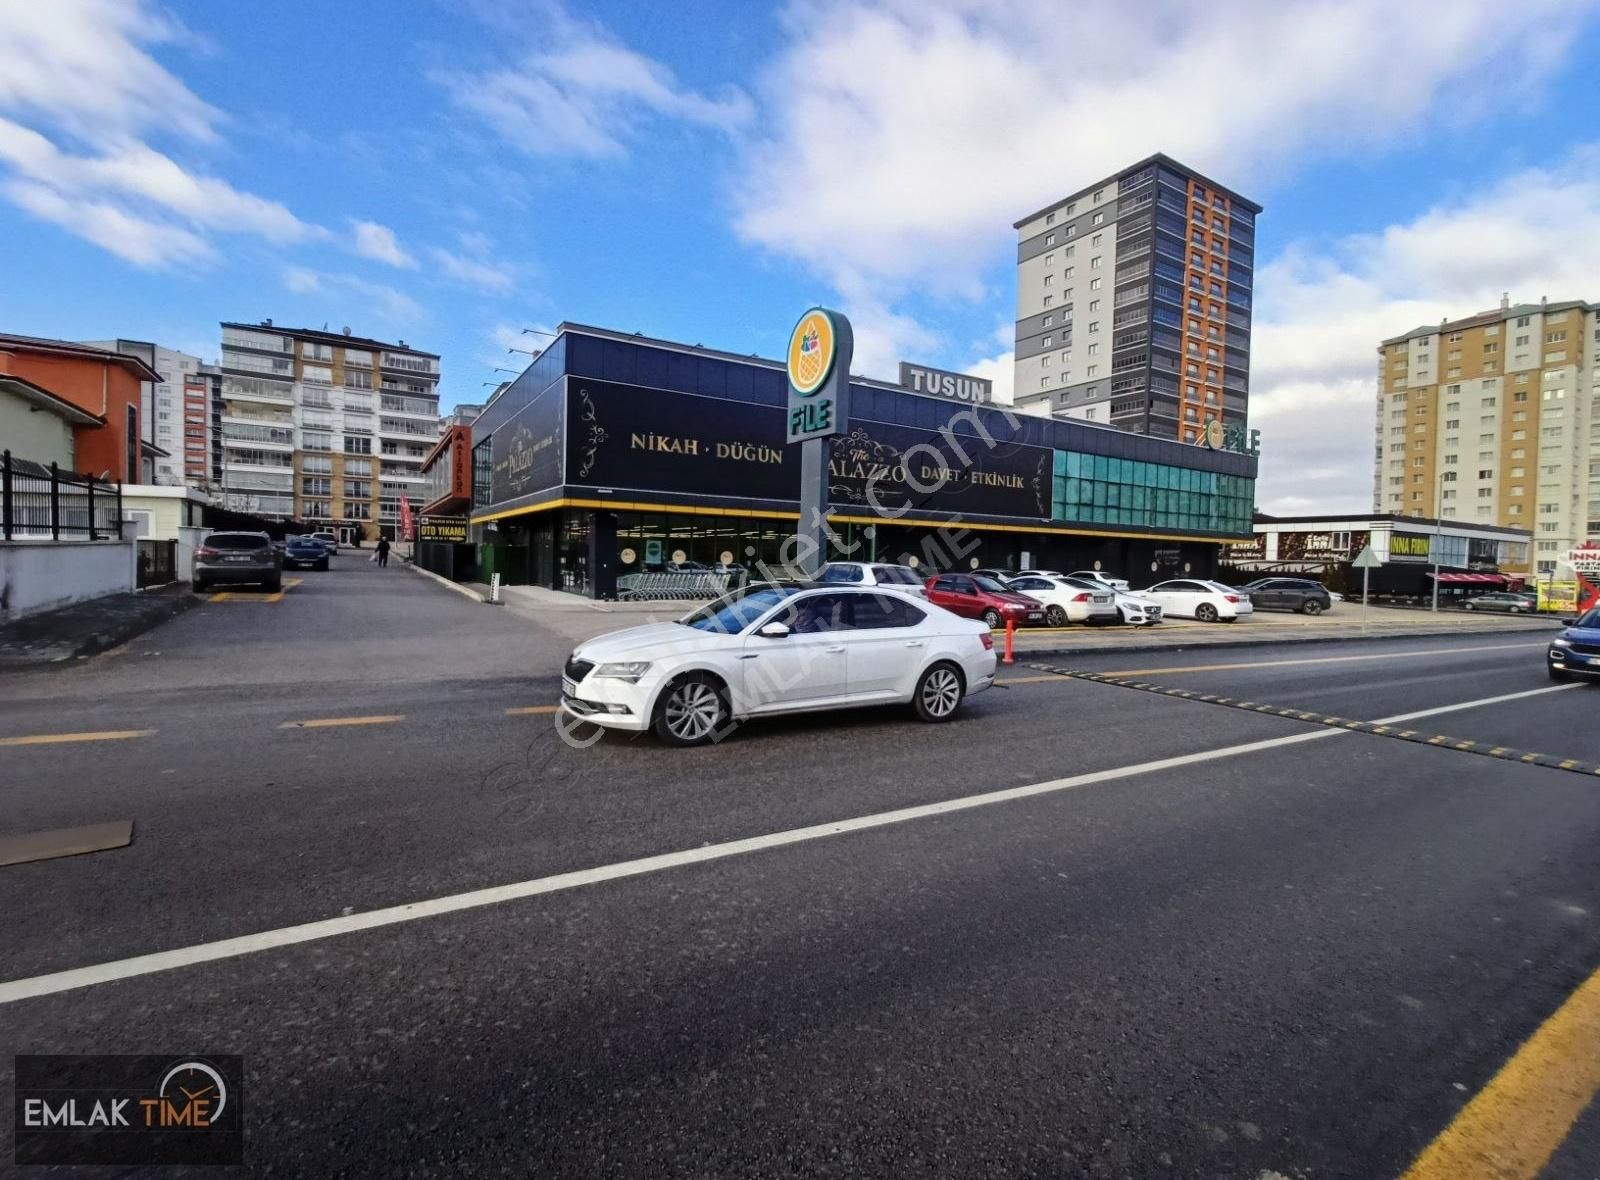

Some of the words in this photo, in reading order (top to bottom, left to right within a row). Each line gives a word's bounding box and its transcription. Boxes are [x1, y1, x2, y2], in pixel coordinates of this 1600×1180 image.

[910, 369, 985, 404] TUSUN
[630, 432, 699, 456] NİKAH
[716, 441, 783, 464] DÜĞÜN
[827, 459, 907, 482] ALAZZO
[921, 466, 961, 481] DAVET
[971, 471, 1025, 489] ETKİNLİK
[421, 526, 436, 536] OTO
[438, 526, 466, 537] YIKAMA
